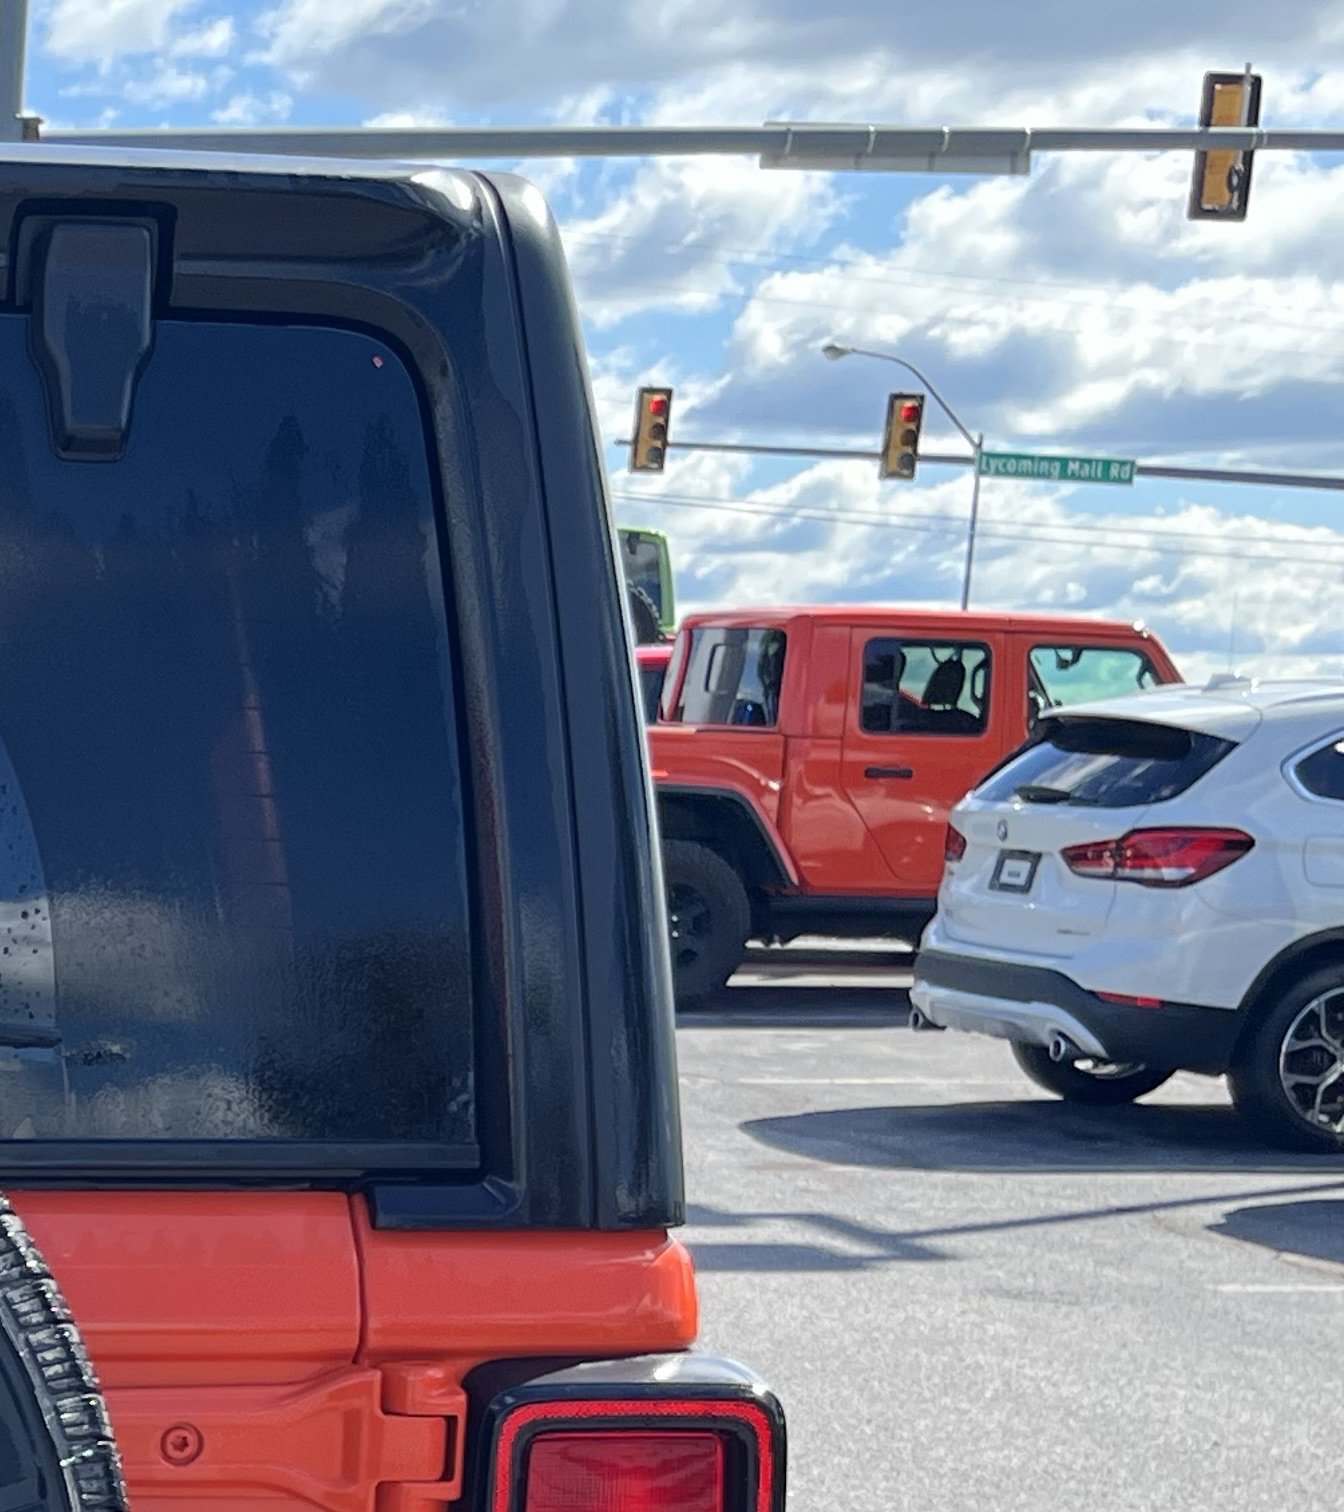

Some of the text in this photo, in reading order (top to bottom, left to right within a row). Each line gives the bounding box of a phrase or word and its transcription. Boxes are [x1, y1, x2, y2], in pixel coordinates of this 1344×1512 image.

[981, 455, 1131, 480] Lycoming Mall Rd
